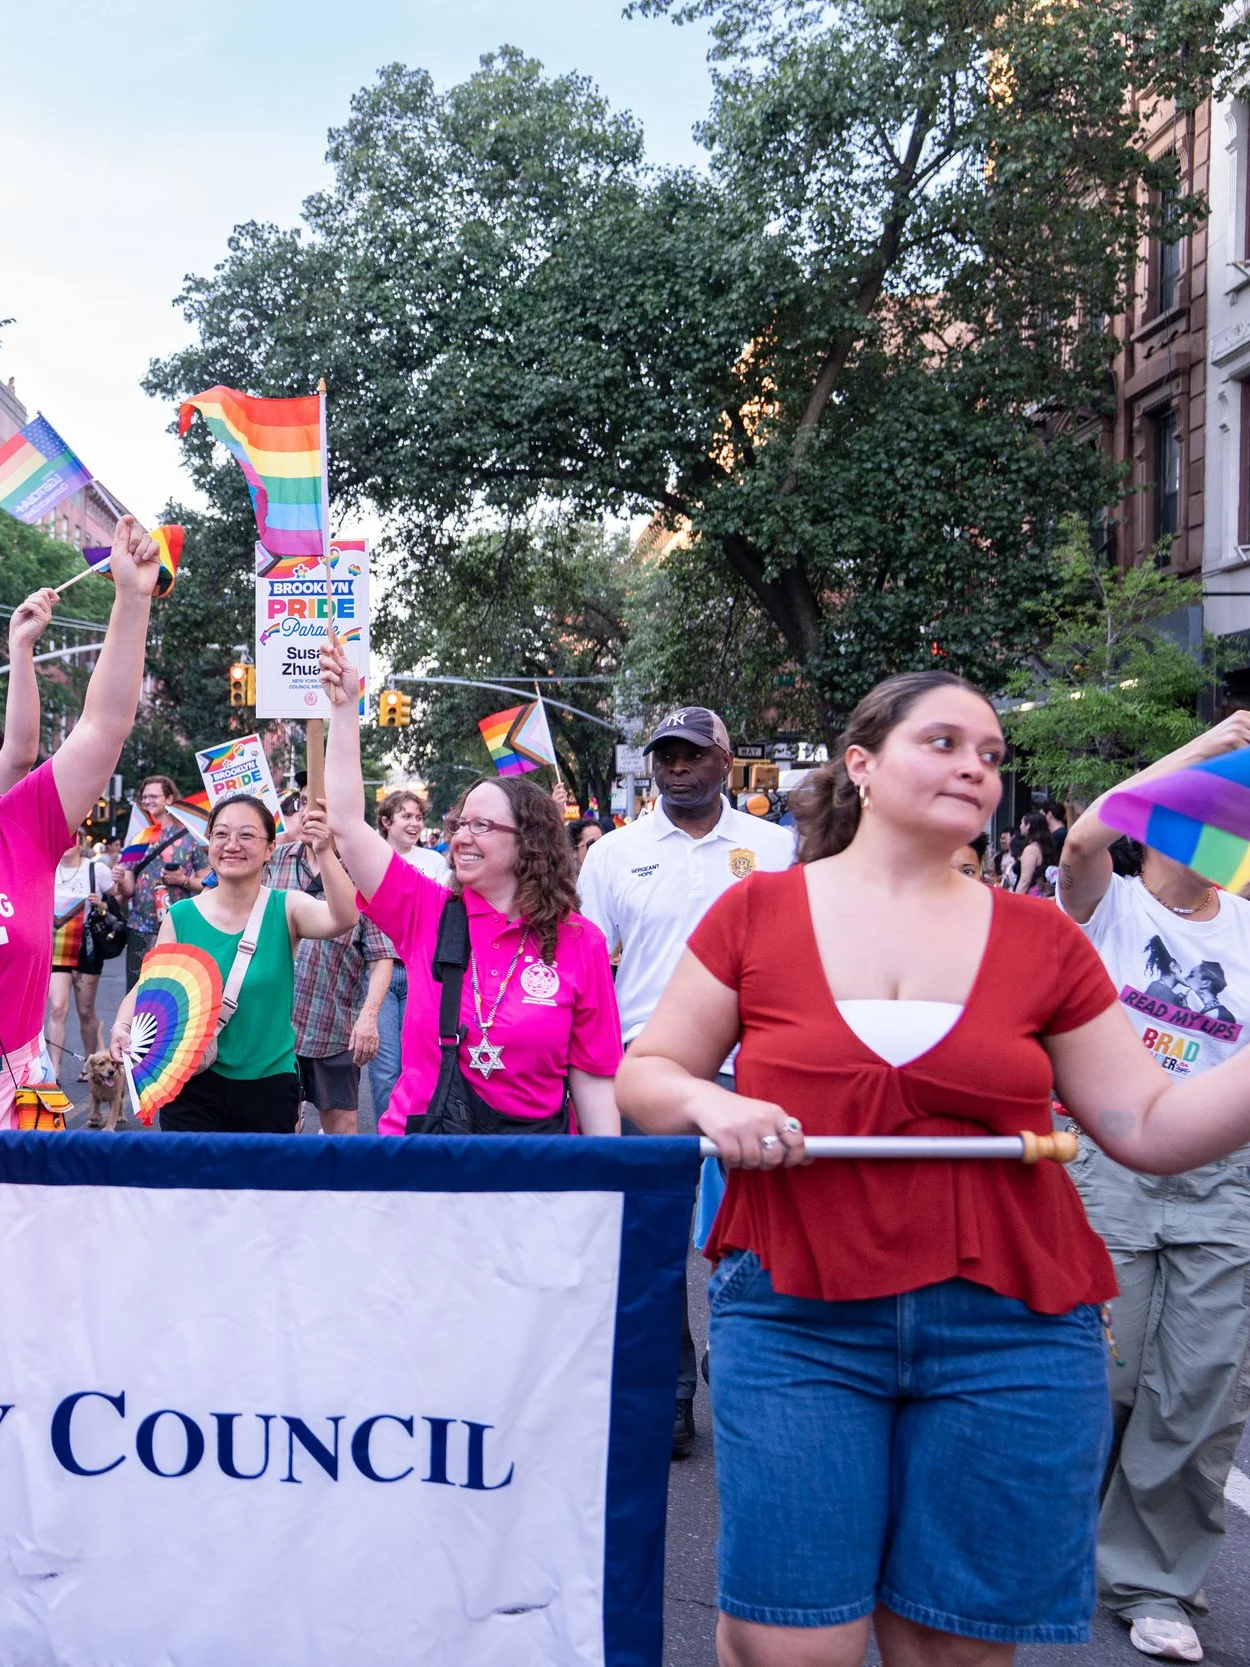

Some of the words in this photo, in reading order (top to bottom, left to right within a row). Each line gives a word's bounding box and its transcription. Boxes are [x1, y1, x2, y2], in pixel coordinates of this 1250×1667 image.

[268, 598, 354, 619] PRIDE
[282, 663, 321, 676] Zhua
[666, 712, 688, 727] NY
[213, 761, 255, 781] BROOKLYN
[213, 770, 262, 795] PRIDE
[630, 863, 660, 874] SERGEANT
[638, 870, 654, 878] HOPE
[1124, 991, 1168, 1016] READ
[1169, 1010, 1201, 1027] MY
[1200, 1019, 1236, 1039] LIPS
[1142, 1028, 1200, 1062] BRAD
[51, 1390, 514, 1490] COUNCIL
